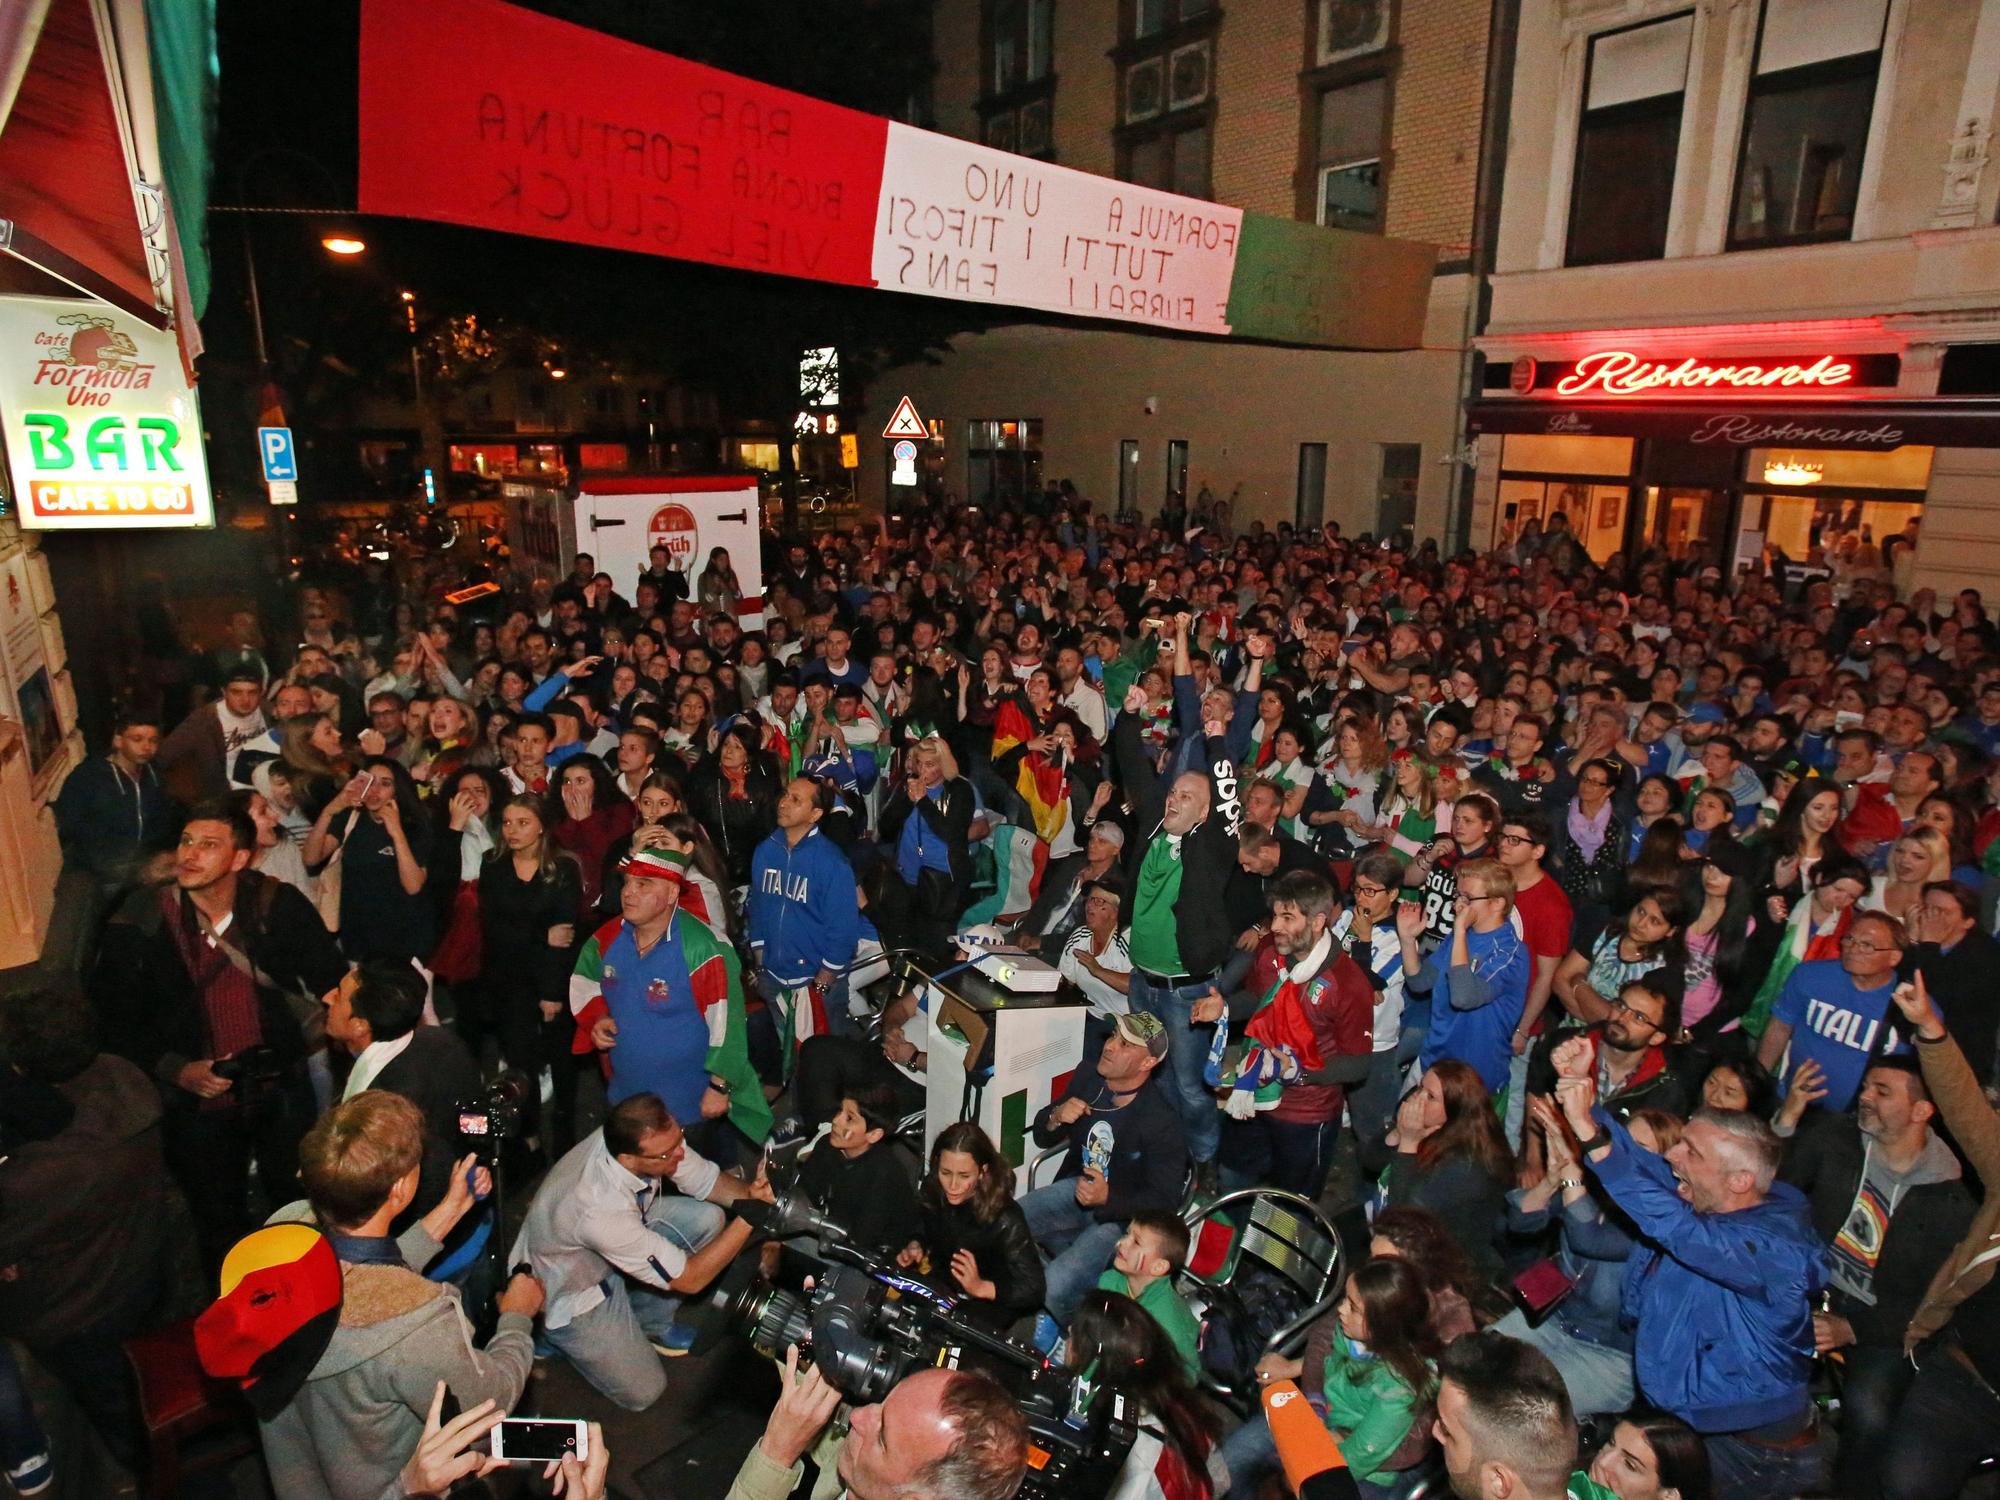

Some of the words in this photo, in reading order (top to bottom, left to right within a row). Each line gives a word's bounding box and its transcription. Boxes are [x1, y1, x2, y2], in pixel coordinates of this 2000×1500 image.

[34, 332, 69, 347] Cafe
[33, 359, 156, 390] Formula
[1555, 350, 1852, 396] Ristorante
[66, 386, 112, 407] Uno
[23, 412, 185, 471] BAR
[1690, 414, 1905, 446] Ristorante
[265, 433, 287, 464] P
[38, 485, 109, 511] CAFE
[112, 486, 148, 511] TO
[152, 486, 188, 511] GO
[762, 868, 808, 904] ITALIA
